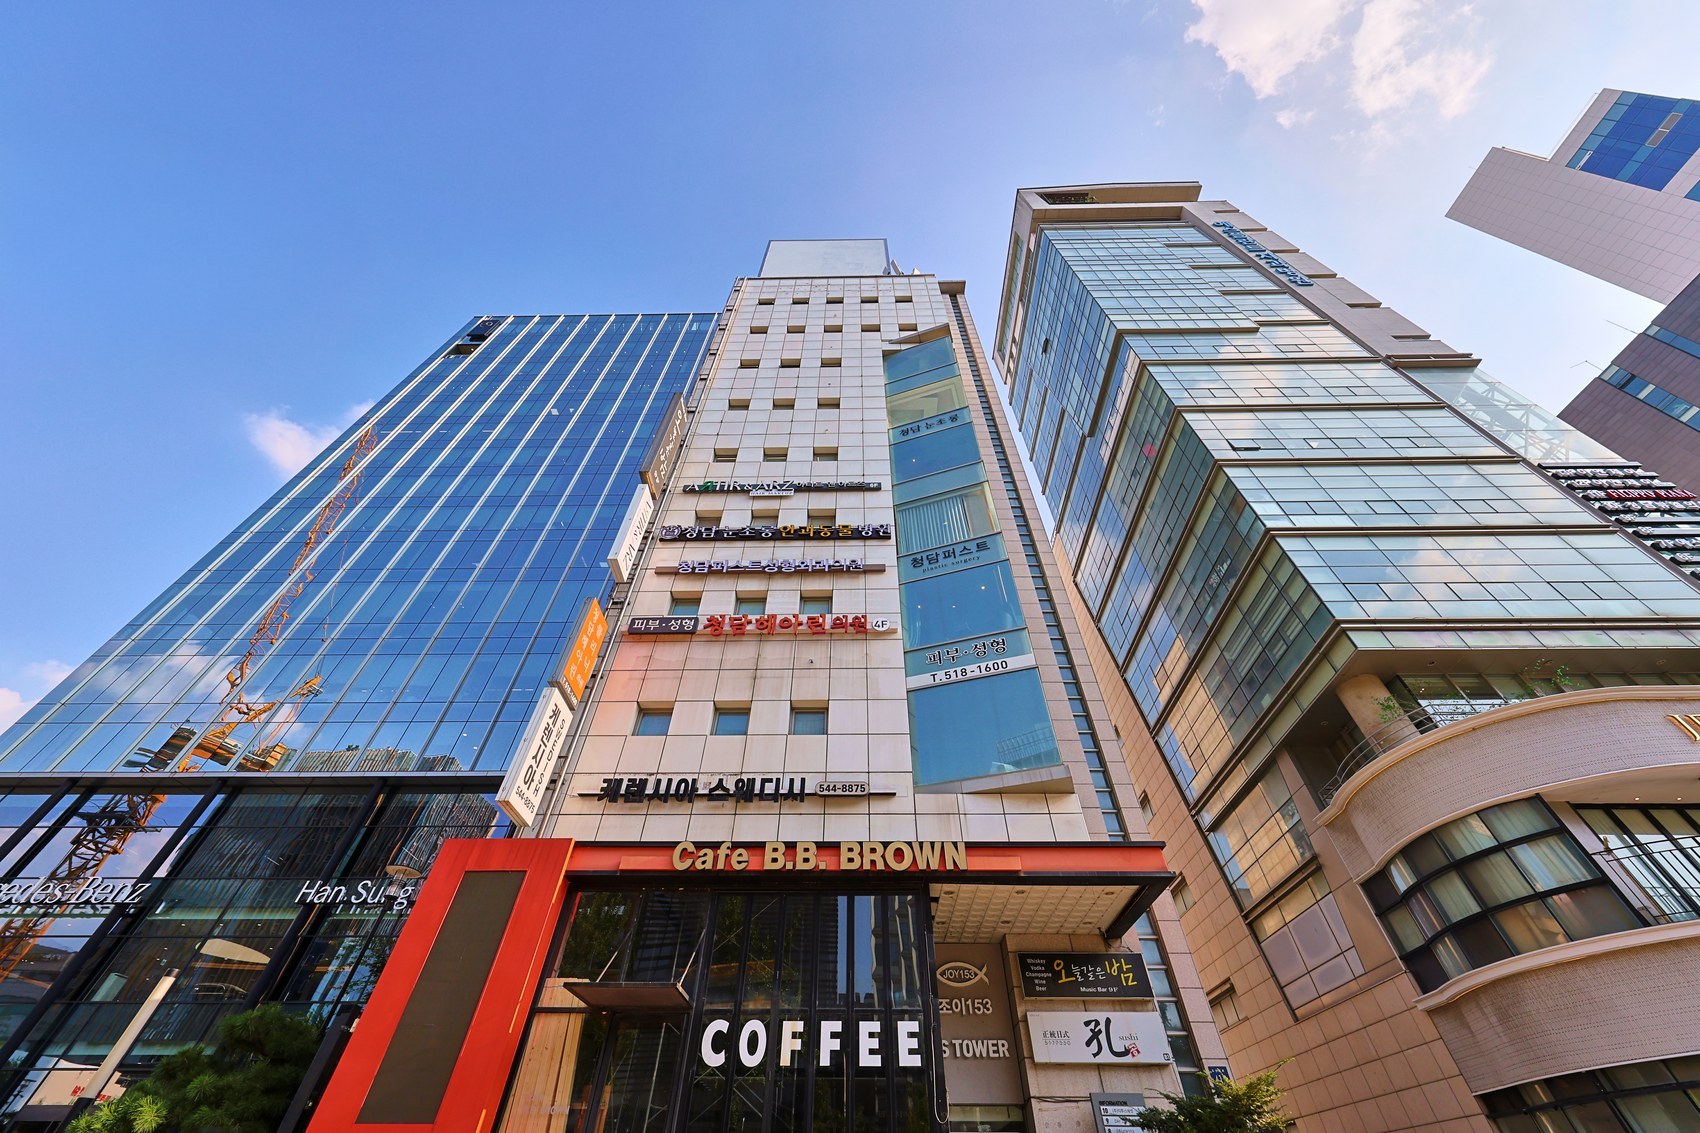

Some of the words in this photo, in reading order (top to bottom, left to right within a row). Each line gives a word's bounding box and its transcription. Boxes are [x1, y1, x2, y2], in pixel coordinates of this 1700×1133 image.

[911, 540, 990, 568] 청담퍼스트
[951, 555, 981, 566] surgery
[873, 619, 888, 629] 4F
[523, 703, 562, 791] 케렌시아
[533, 719, 566, 797] SWEDISH
[515, 786, 536, 814] 544-8875
[597, 777, 698, 803] 케렌시아
[707, 777, 806, 803] 스웨디시
[818, 782, 866, 794] 544-8875
[672, 841, 749, 871] Cafe
[763, 841, 827, 870] B.B.
[840, 841, 968, 871] BROWN
[0, 877, 152, 904] edes-Benz
[295, 880, 346, 903] Han
[351, 880, 416, 910] Sug
[943, 969, 975, 979] JOY153
[939, 998, 993, 1015] 조이153
[701, 1019, 922, 1067] COFFEE
[952, 1039, 1010, 1058] TOWER
[1118, 1032, 1139, 1041] sushi
